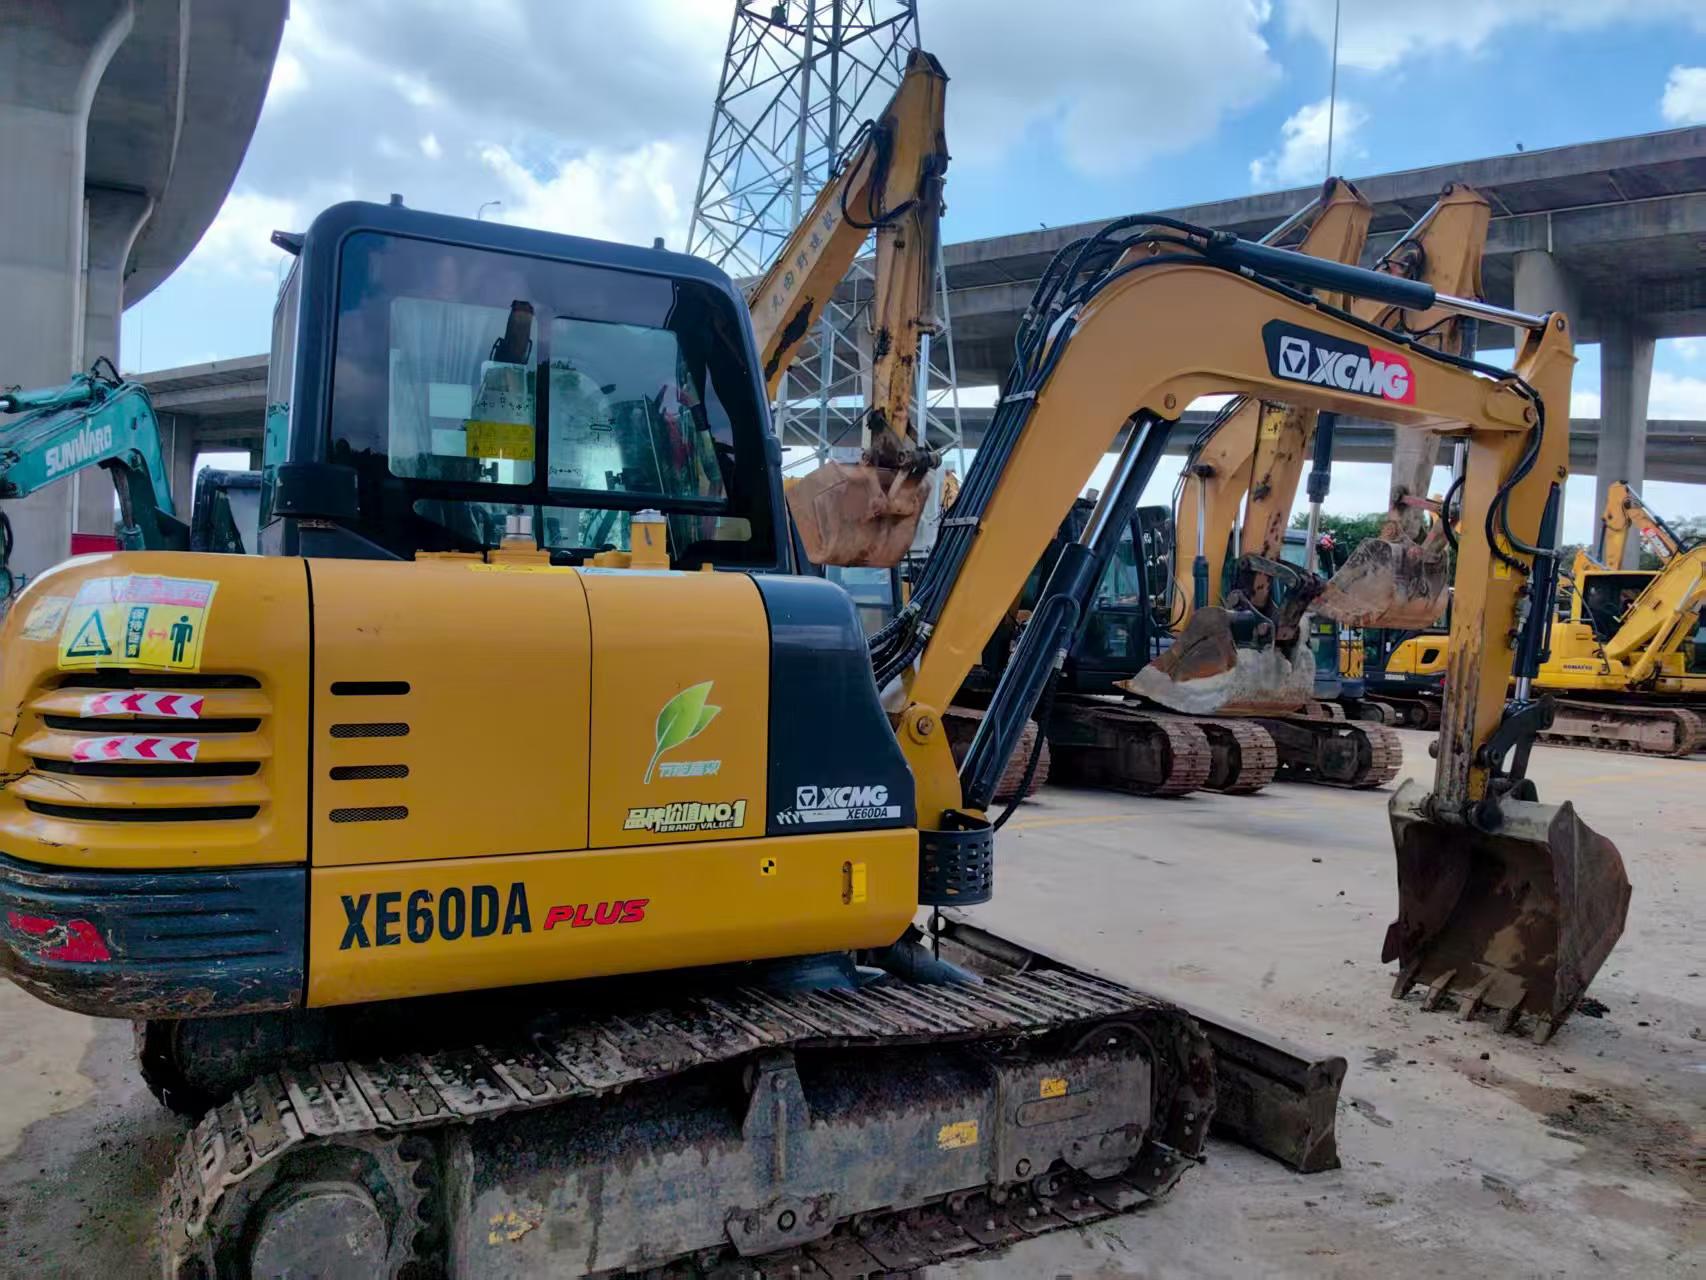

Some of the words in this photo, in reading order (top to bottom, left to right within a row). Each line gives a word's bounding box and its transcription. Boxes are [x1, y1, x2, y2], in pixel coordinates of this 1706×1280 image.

[1307, 347, 1409, 400] XCMG
[45, 418, 112, 477] SUNWARD
[817, 785, 889, 808] XCMG
[846, 807, 888, 820] XE60DA
[660, 823, 696, 832] BRAND
[699, 821, 733, 830] VALUE
[339, 881, 532, 951] XE60DA
[543, 898, 650, 930] PLUS
